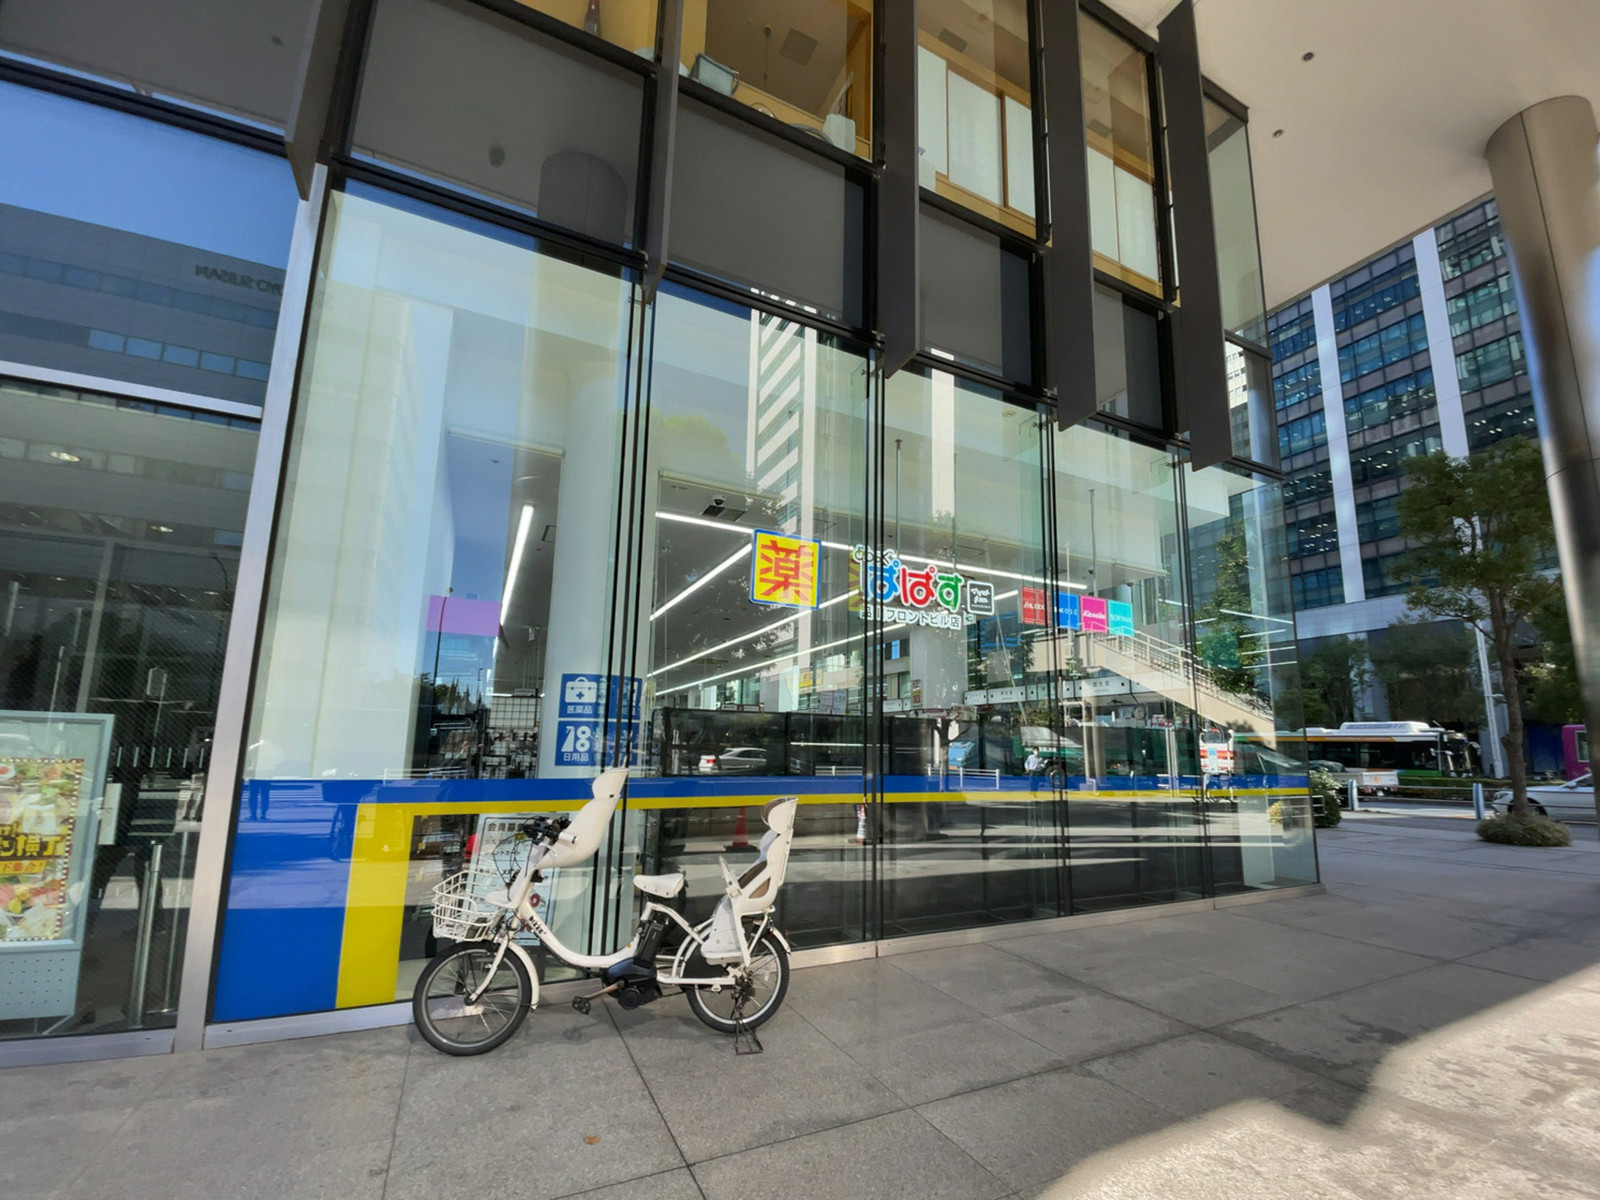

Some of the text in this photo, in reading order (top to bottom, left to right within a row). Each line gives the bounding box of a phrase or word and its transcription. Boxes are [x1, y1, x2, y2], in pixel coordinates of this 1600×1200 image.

[759, 539, 815, 602] 薬
[567, 705, 592, 714] 医薬品
[563, 753, 589, 762] 日用品
